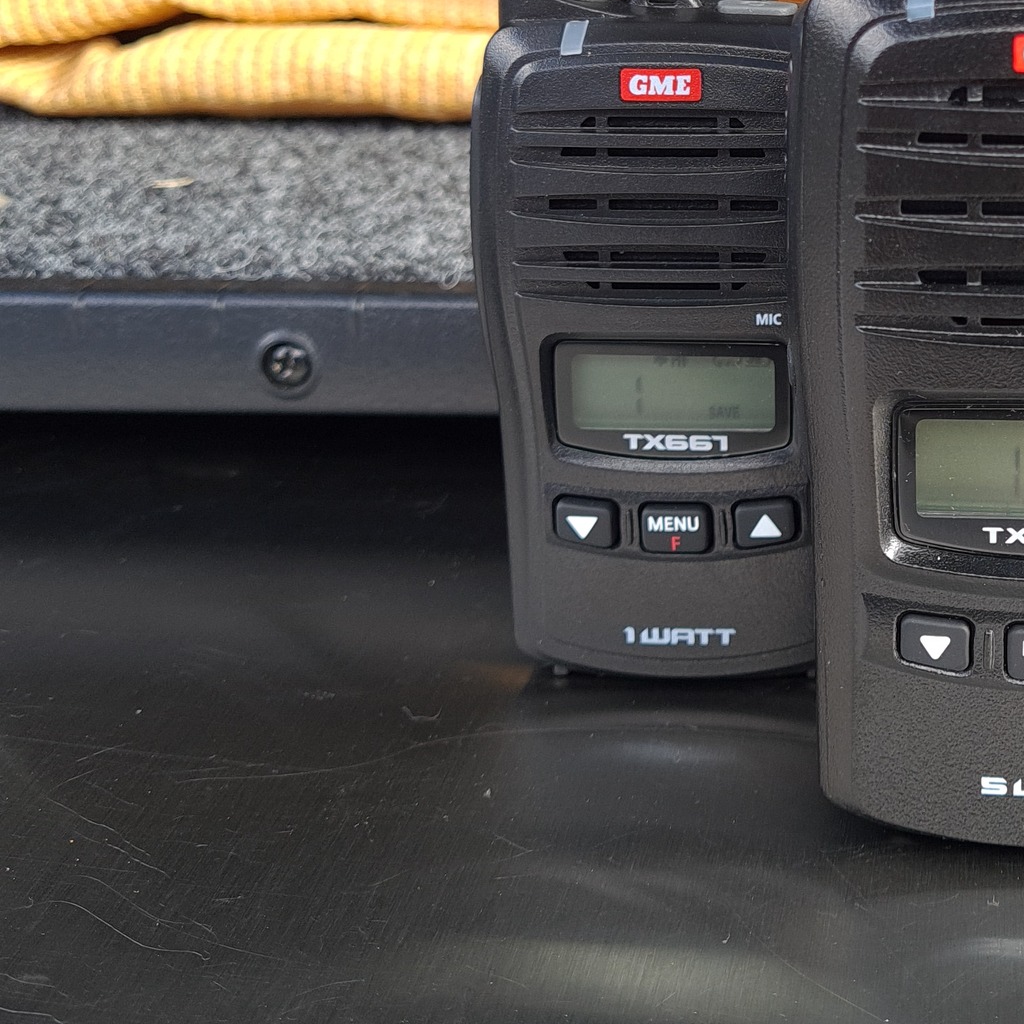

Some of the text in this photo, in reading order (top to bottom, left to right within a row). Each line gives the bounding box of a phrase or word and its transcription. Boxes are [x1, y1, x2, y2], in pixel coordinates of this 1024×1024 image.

[628, 74, 692, 96] GME
[755, 313, 782, 326] MIC
[708, 405, 740, 420] SAVE
[647, 516, 700, 532] MENU
[670, 536, 681, 551] F
[622, 626, 737, 646] 1 WATT
[980, 776, 1008, 796] 5
